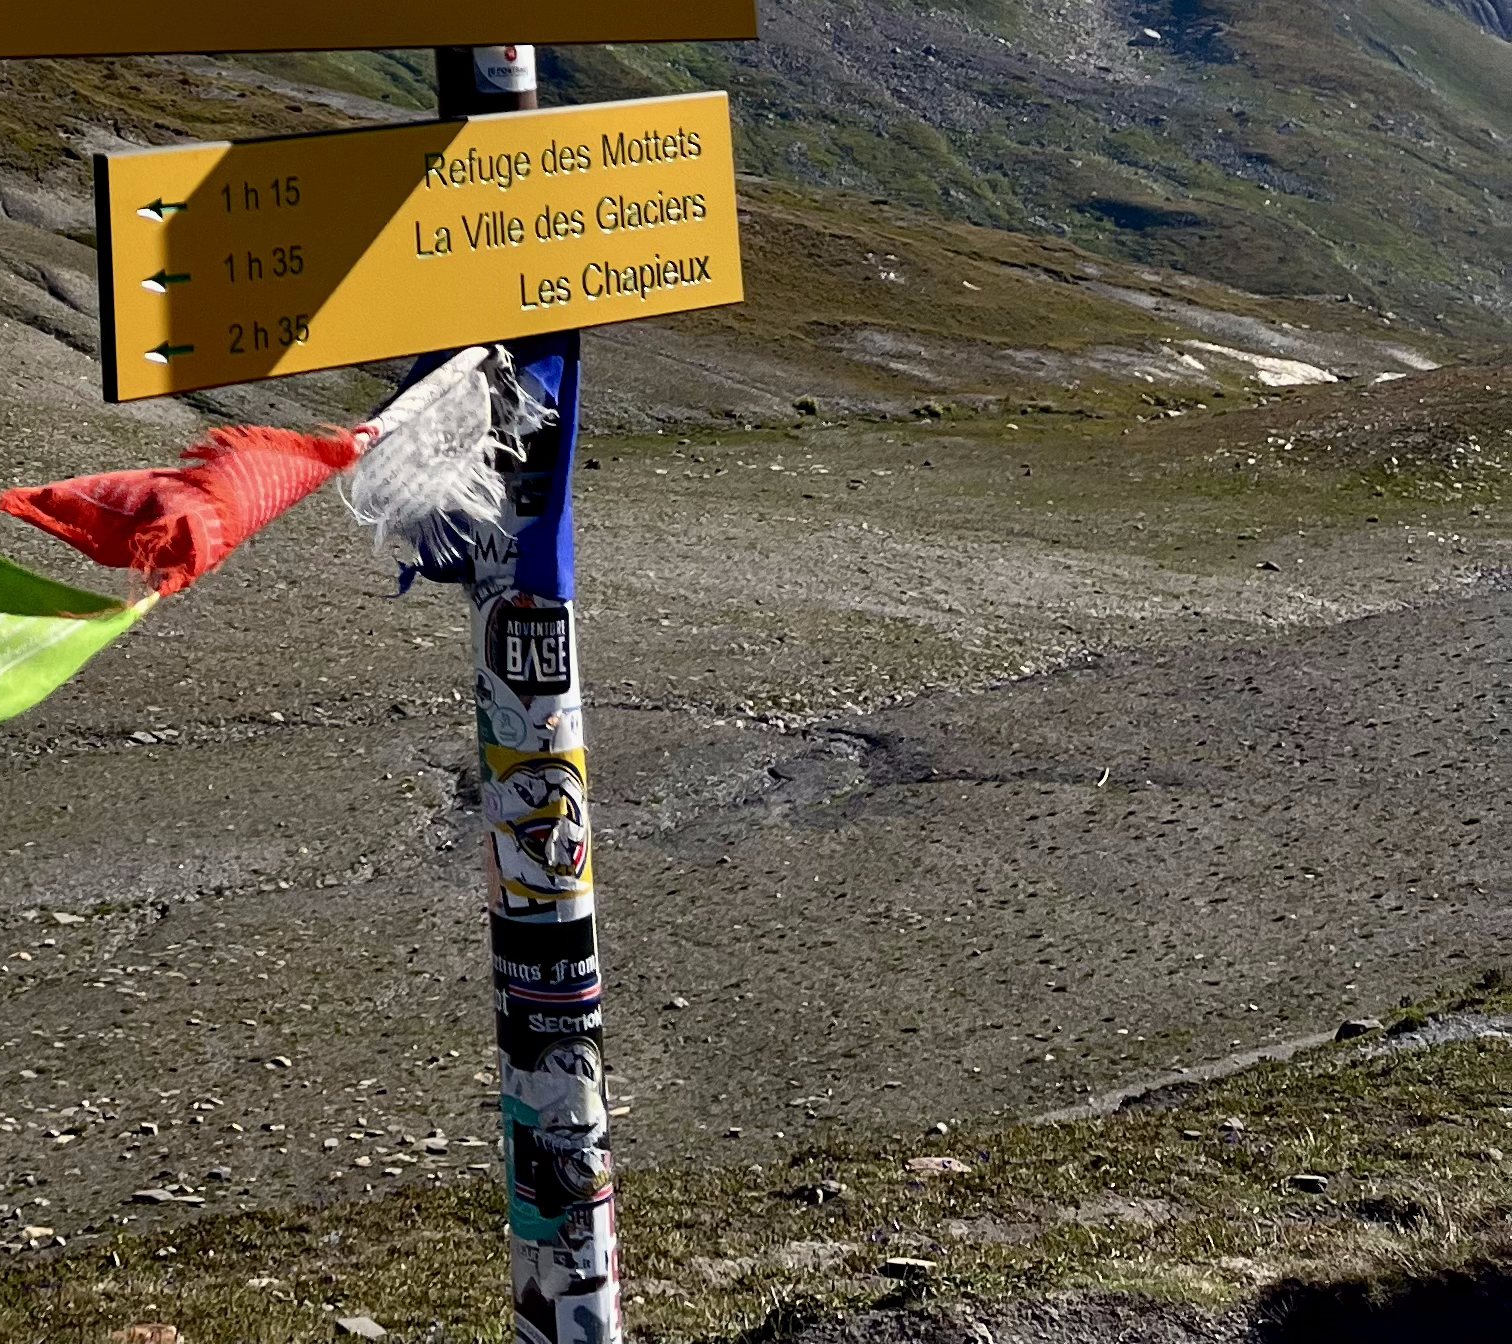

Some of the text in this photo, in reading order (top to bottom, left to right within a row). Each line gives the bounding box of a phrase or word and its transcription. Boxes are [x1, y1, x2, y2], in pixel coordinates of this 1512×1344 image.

[424, 126, 703, 191] Refuge des Mottets
[221, 176, 301, 212] 1 h 15
[415, 190, 707, 259] La Ville des Glaciers
[223, 245, 304, 283] 1 h 35
[520, 253, 712, 311] Les Chapieux
[228, 314, 310, 354] 2 h 35
[506, 636, 567, 682] BASE
